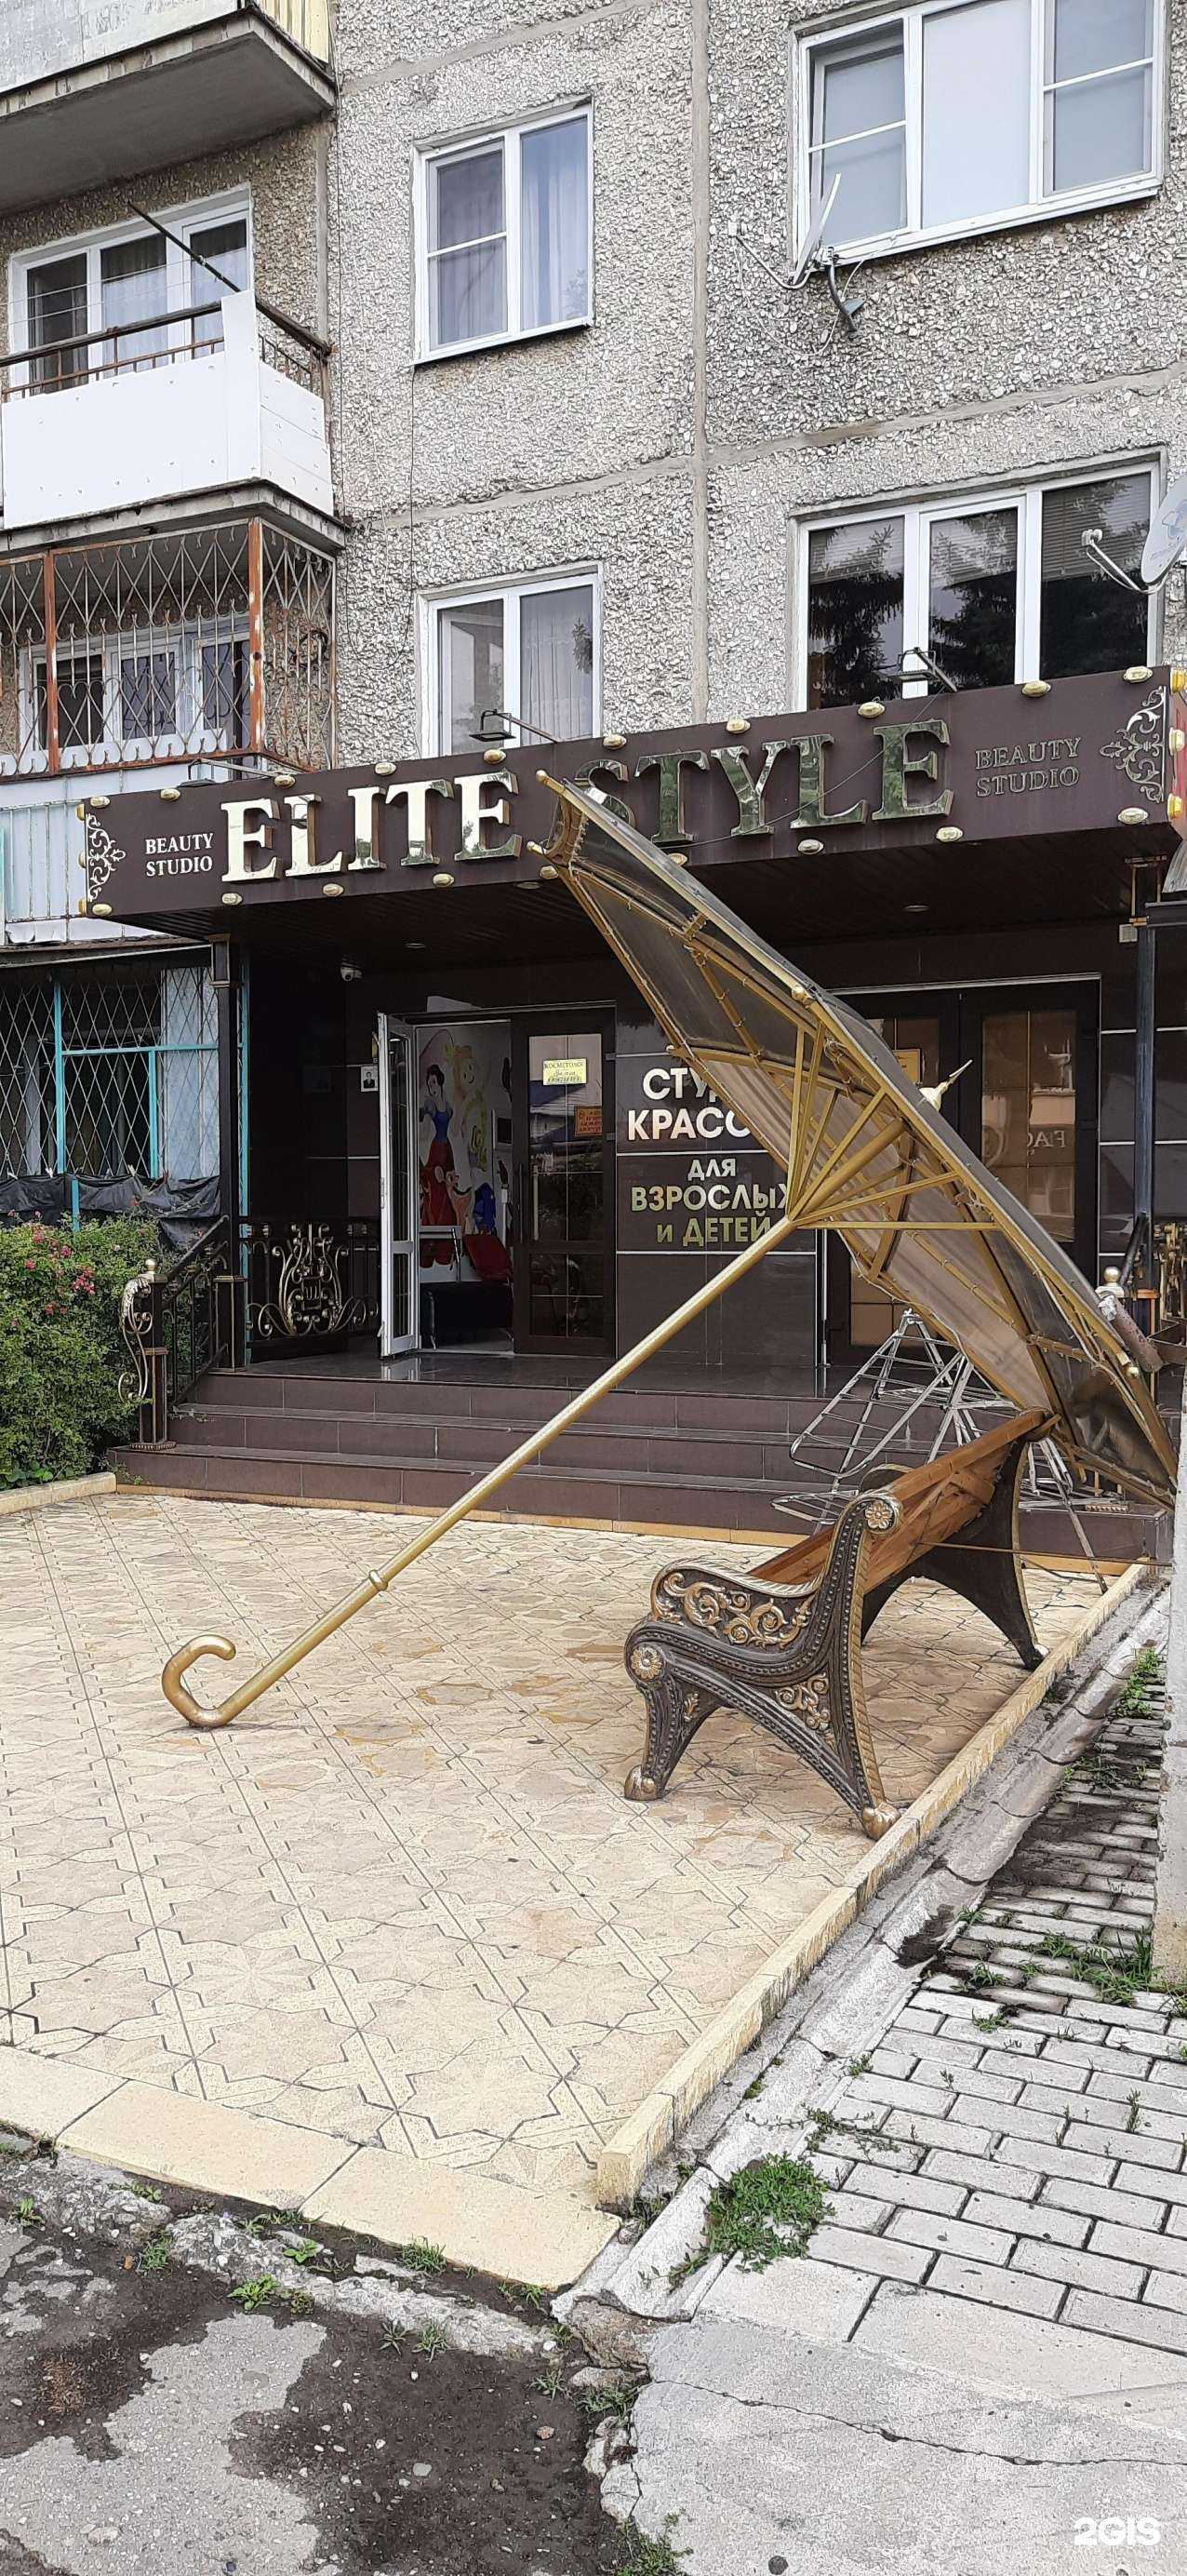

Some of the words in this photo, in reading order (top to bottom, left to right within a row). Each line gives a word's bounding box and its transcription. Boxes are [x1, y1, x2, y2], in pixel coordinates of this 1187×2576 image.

[975, 736, 1082, 770] BEAUTY
[976, 766, 1080, 797] STUDIO
[220, 768, 523, 883] ELITE
[575, 718, 954, 842] STYLE
[145, 832, 214, 854] BEAUTY
[145, 854, 214, 877] STUDIO
[643, 1067, 719, 1102] СТУ
[682, 1210, 771, 1247] ДЕТЕЙ
